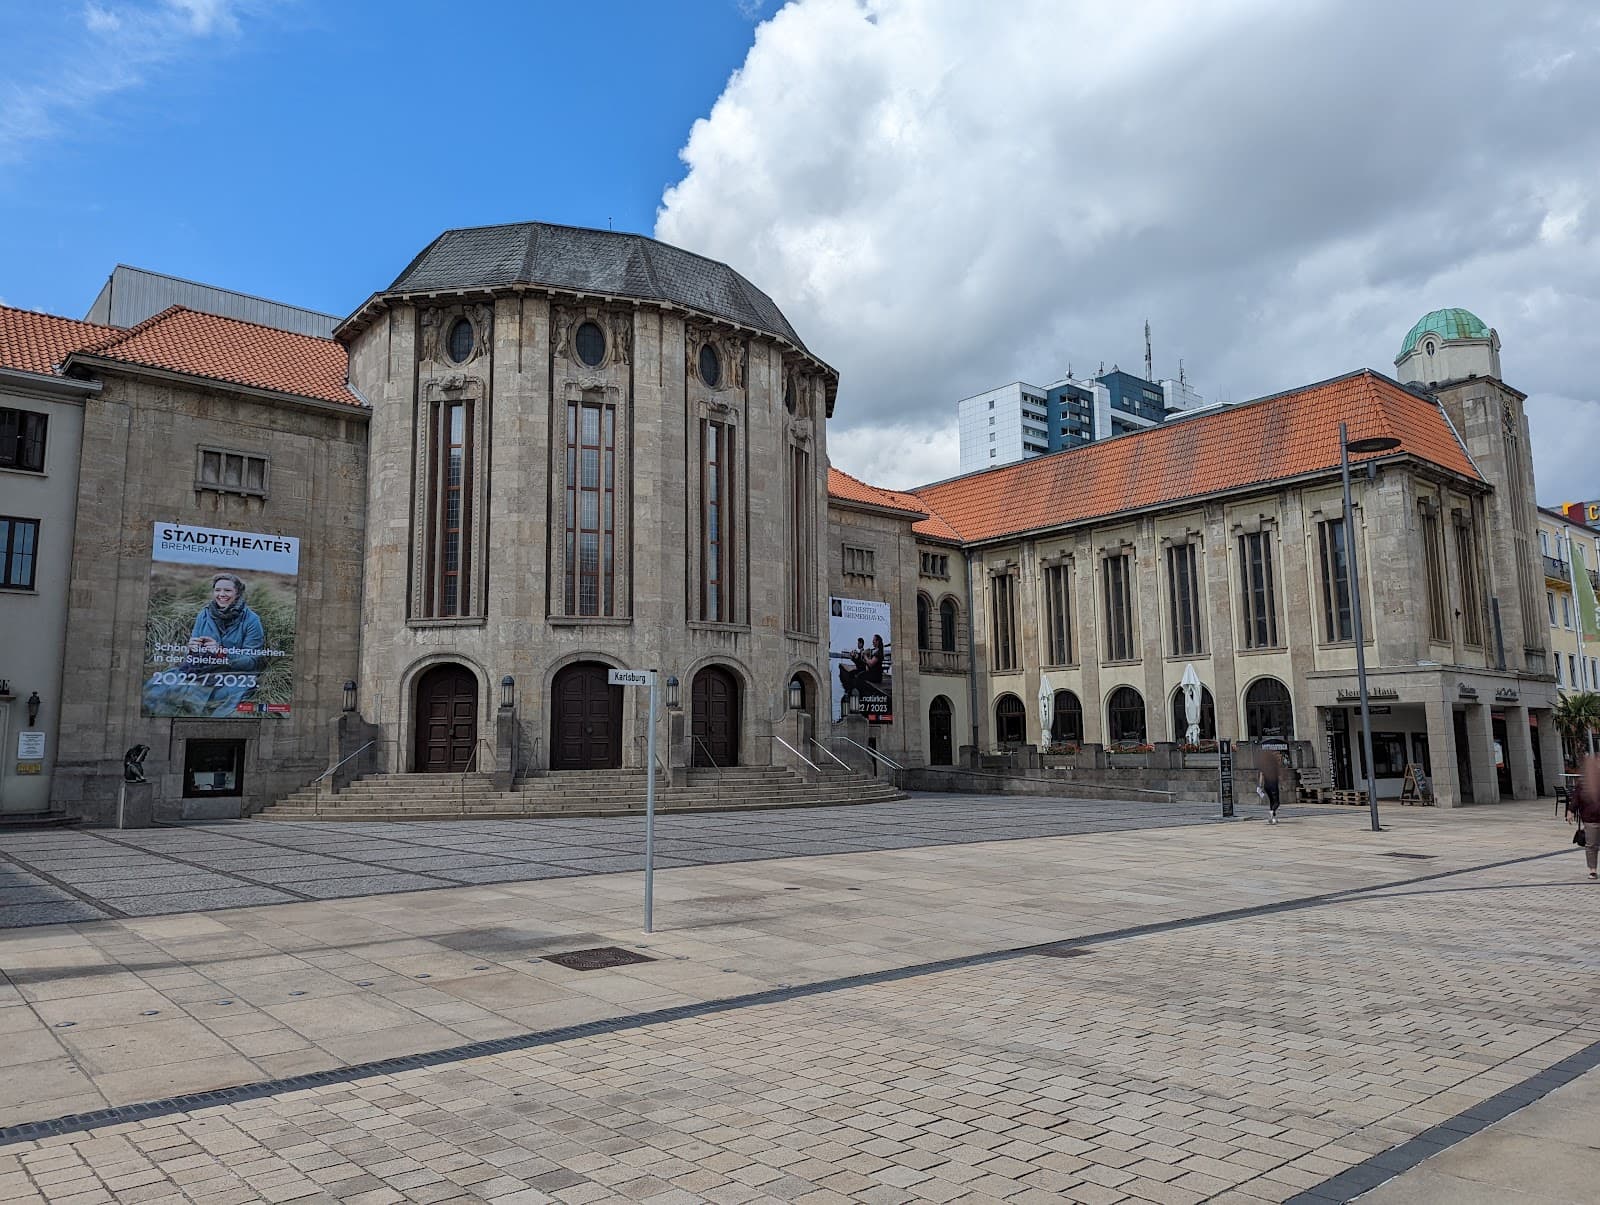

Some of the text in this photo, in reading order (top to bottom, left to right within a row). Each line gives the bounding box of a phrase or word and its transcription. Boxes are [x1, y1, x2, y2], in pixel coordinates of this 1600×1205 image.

[162, 529, 292, 553] STADTTHEATER
[161, 541, 240, 556] BREMERHAVEN
[154, 643, 285, 657] Schön, Sie wiederzusehen
[165, 655, 184, 663] der
[152, 672, 197, 685] 2022
[214, 675, 260, 688] 2023.
[614, 671, 646, 685] Karlsburg
[1337, 687, 1398, 697] Kleins Haus
[870, 704, 888, 713] 2023
